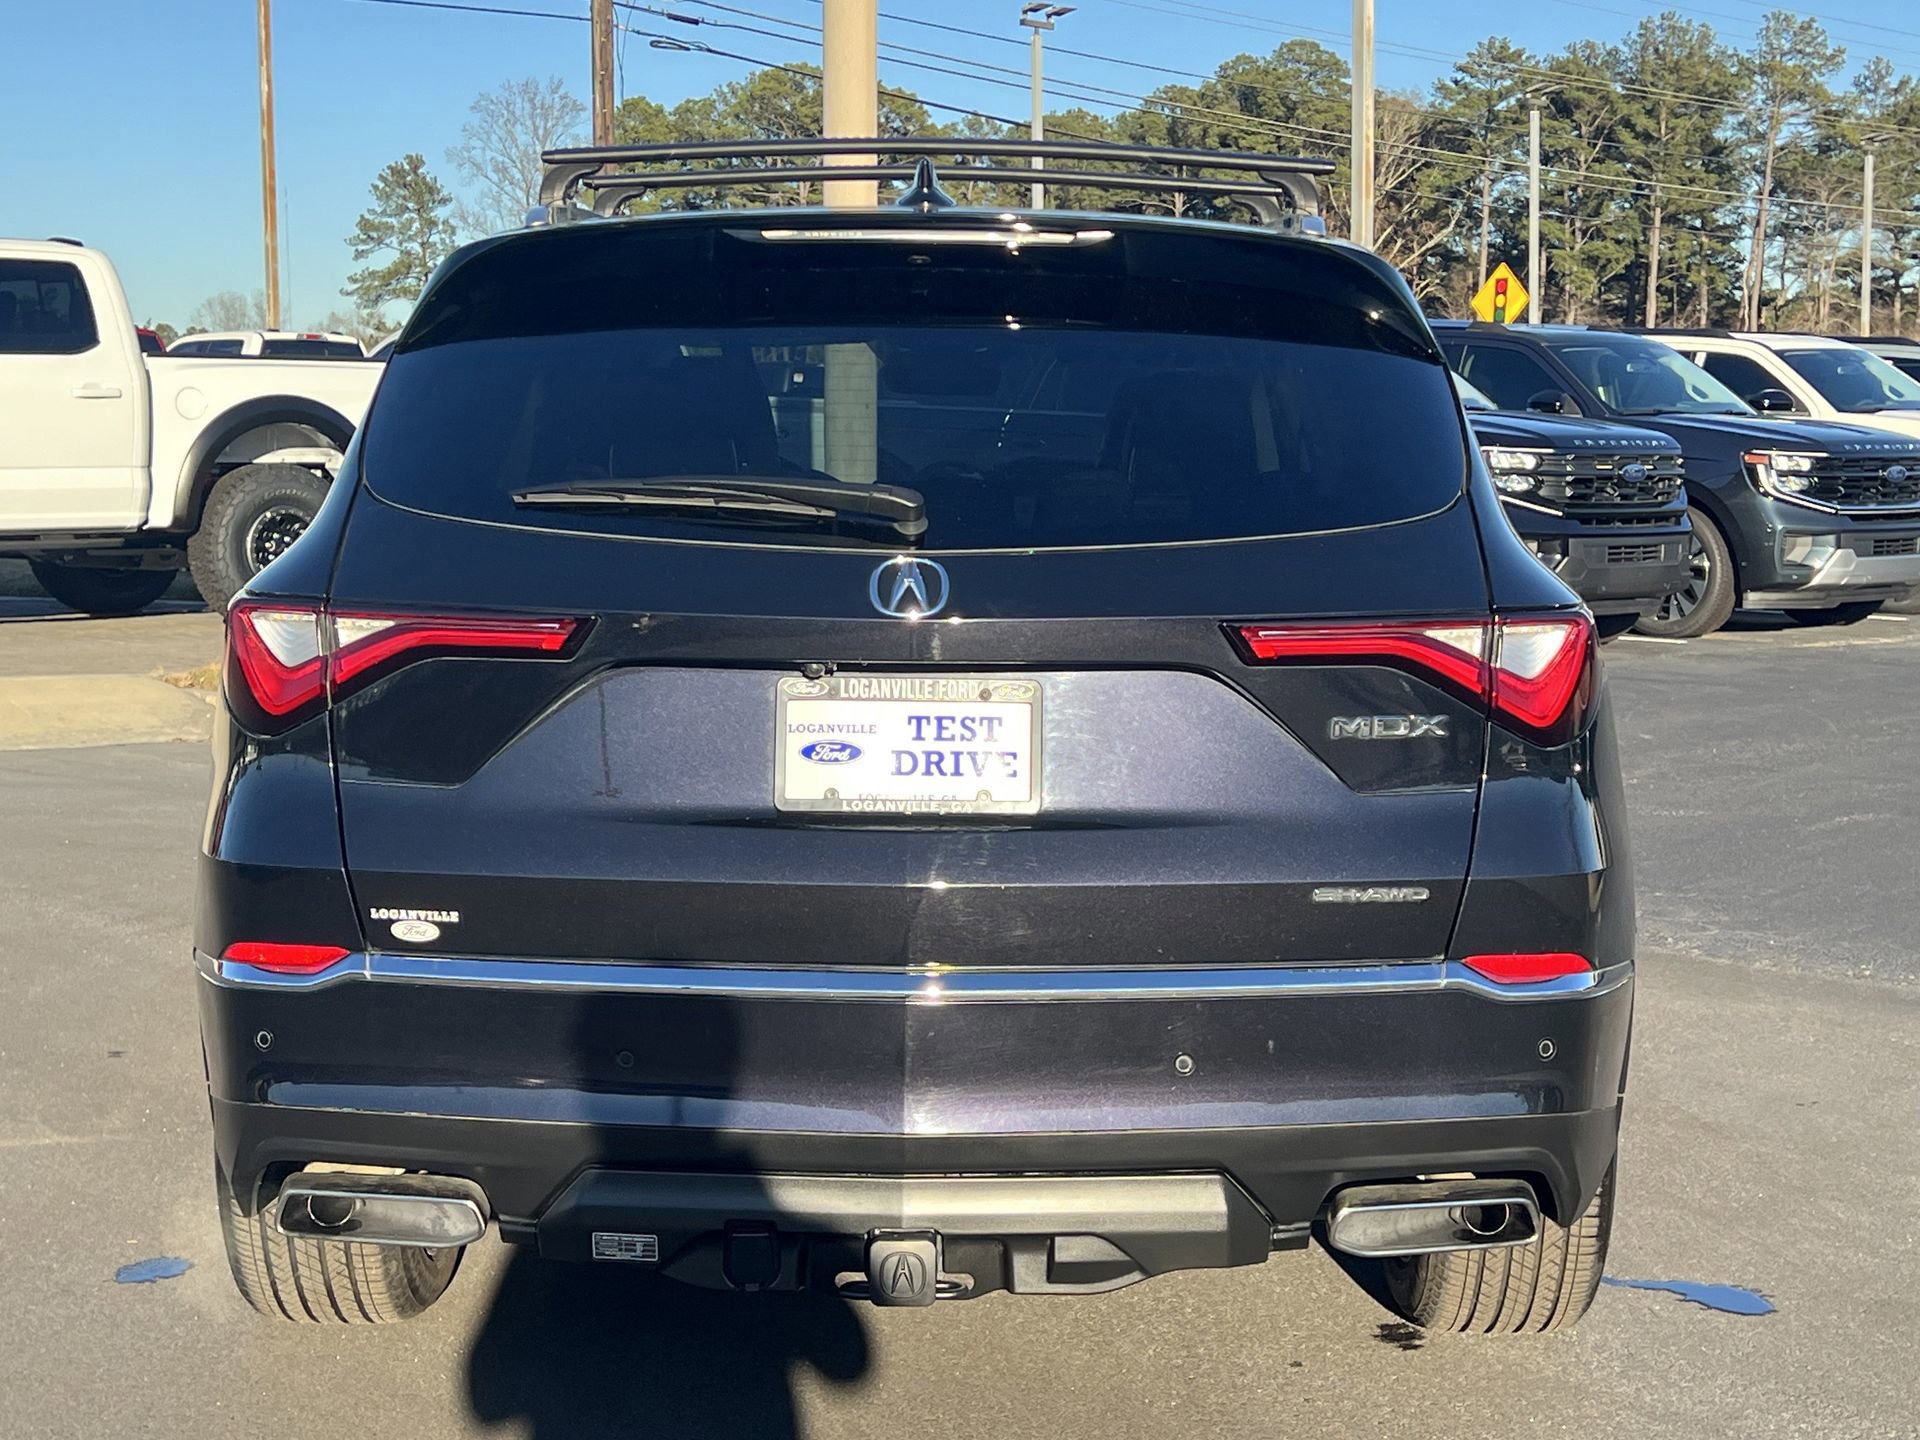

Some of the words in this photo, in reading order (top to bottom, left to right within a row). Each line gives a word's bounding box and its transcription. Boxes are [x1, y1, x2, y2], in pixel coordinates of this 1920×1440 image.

[840, 678, 934, 699] LOGANVILLE
[938, 680, 981, 700] FORD
[788, 723, 877, 735] LOGANVILLE
[907, 715, 1003, 742] TEST
[1329, 714, 1450, 740] MDX
[811, 743, 852, 761] Ford
[890, 750, 1018, 778] DRIVE
[951, 801, 974, 813] GA
[369, 907, 460, 922] LOGANVILLE
